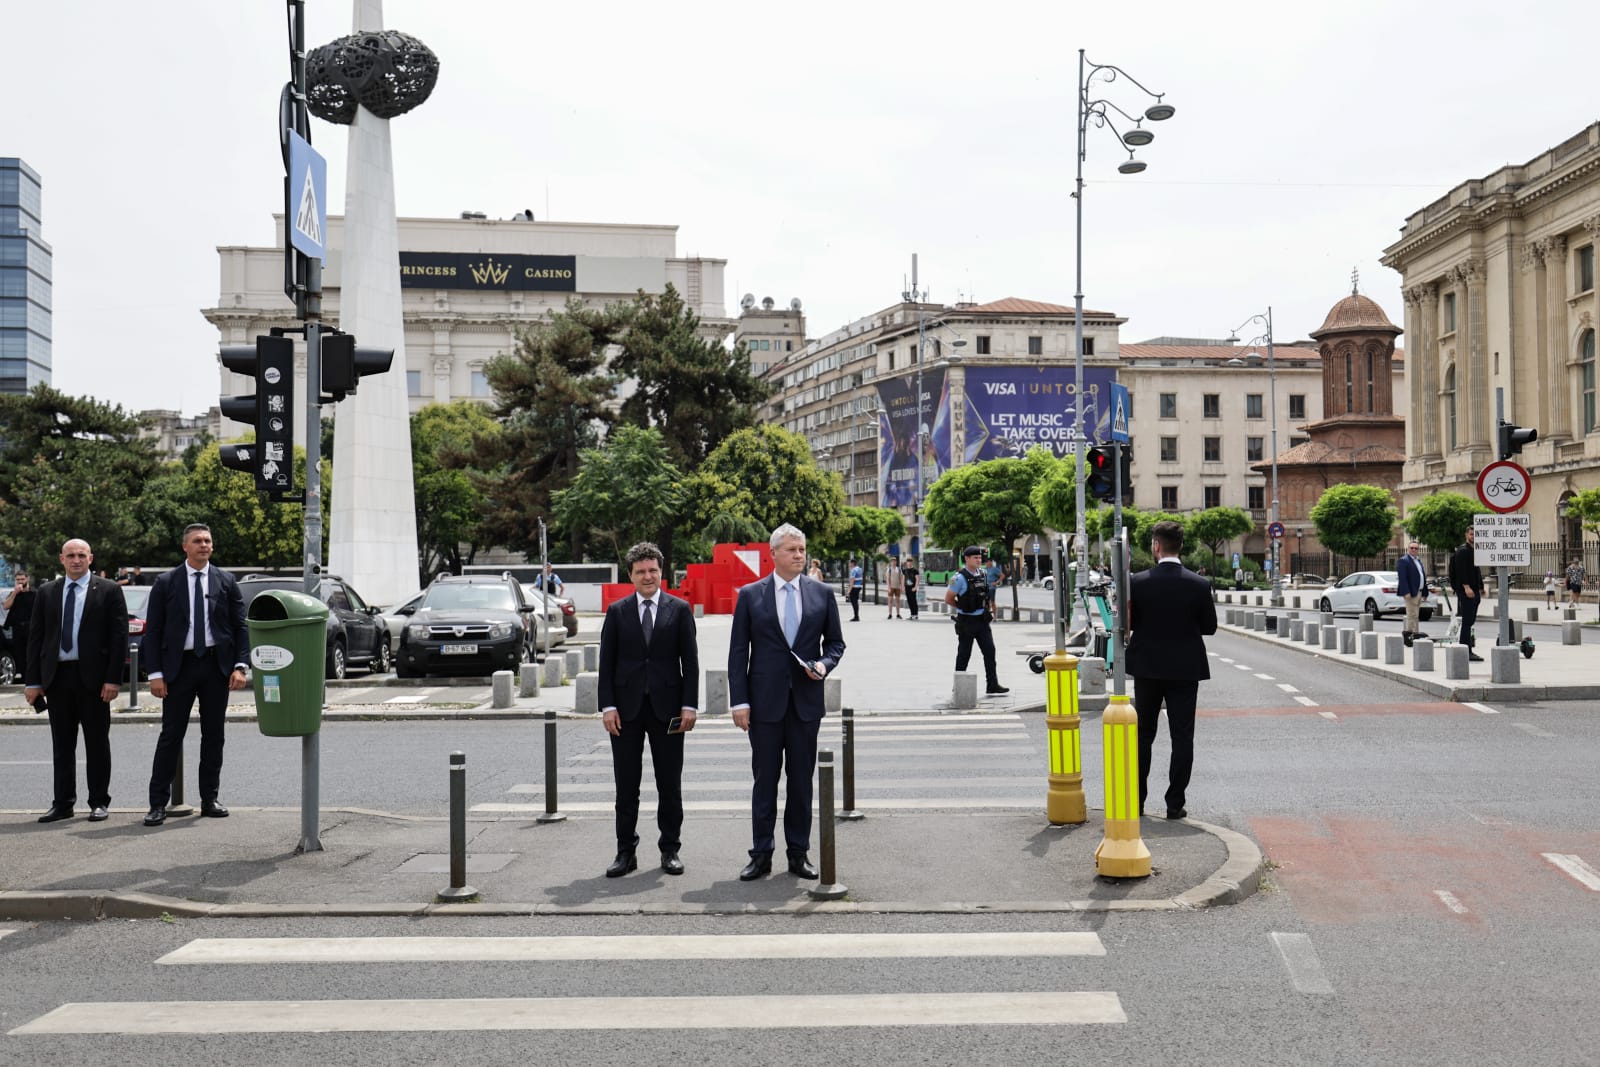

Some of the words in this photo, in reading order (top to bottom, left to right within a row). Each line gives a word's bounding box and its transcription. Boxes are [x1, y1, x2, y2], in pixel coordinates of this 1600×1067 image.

[400, 265, 457, 276] RINCESS
[525, 268, 572, 279] CASINO
[983, 382, 1017, 395] VISA
[1029, 383, 1099, 395] UNTOD
[991, 413, 1016, 426] LET
[1019, 413, 1063, 426] MUSIC
[1001, 427, 1036, 440] TAKE
[1039, 427, 1077, 440] OVER
[1056, 441, 1094, 453] VIBS
[1474, 530, 1488, 538] INTRE
[1474, 542, 1496, 550] INTERZIS
[1502, 542, 1528, 550] BICICLETE
[1498, 554, 1524, 562] TROTINETE
